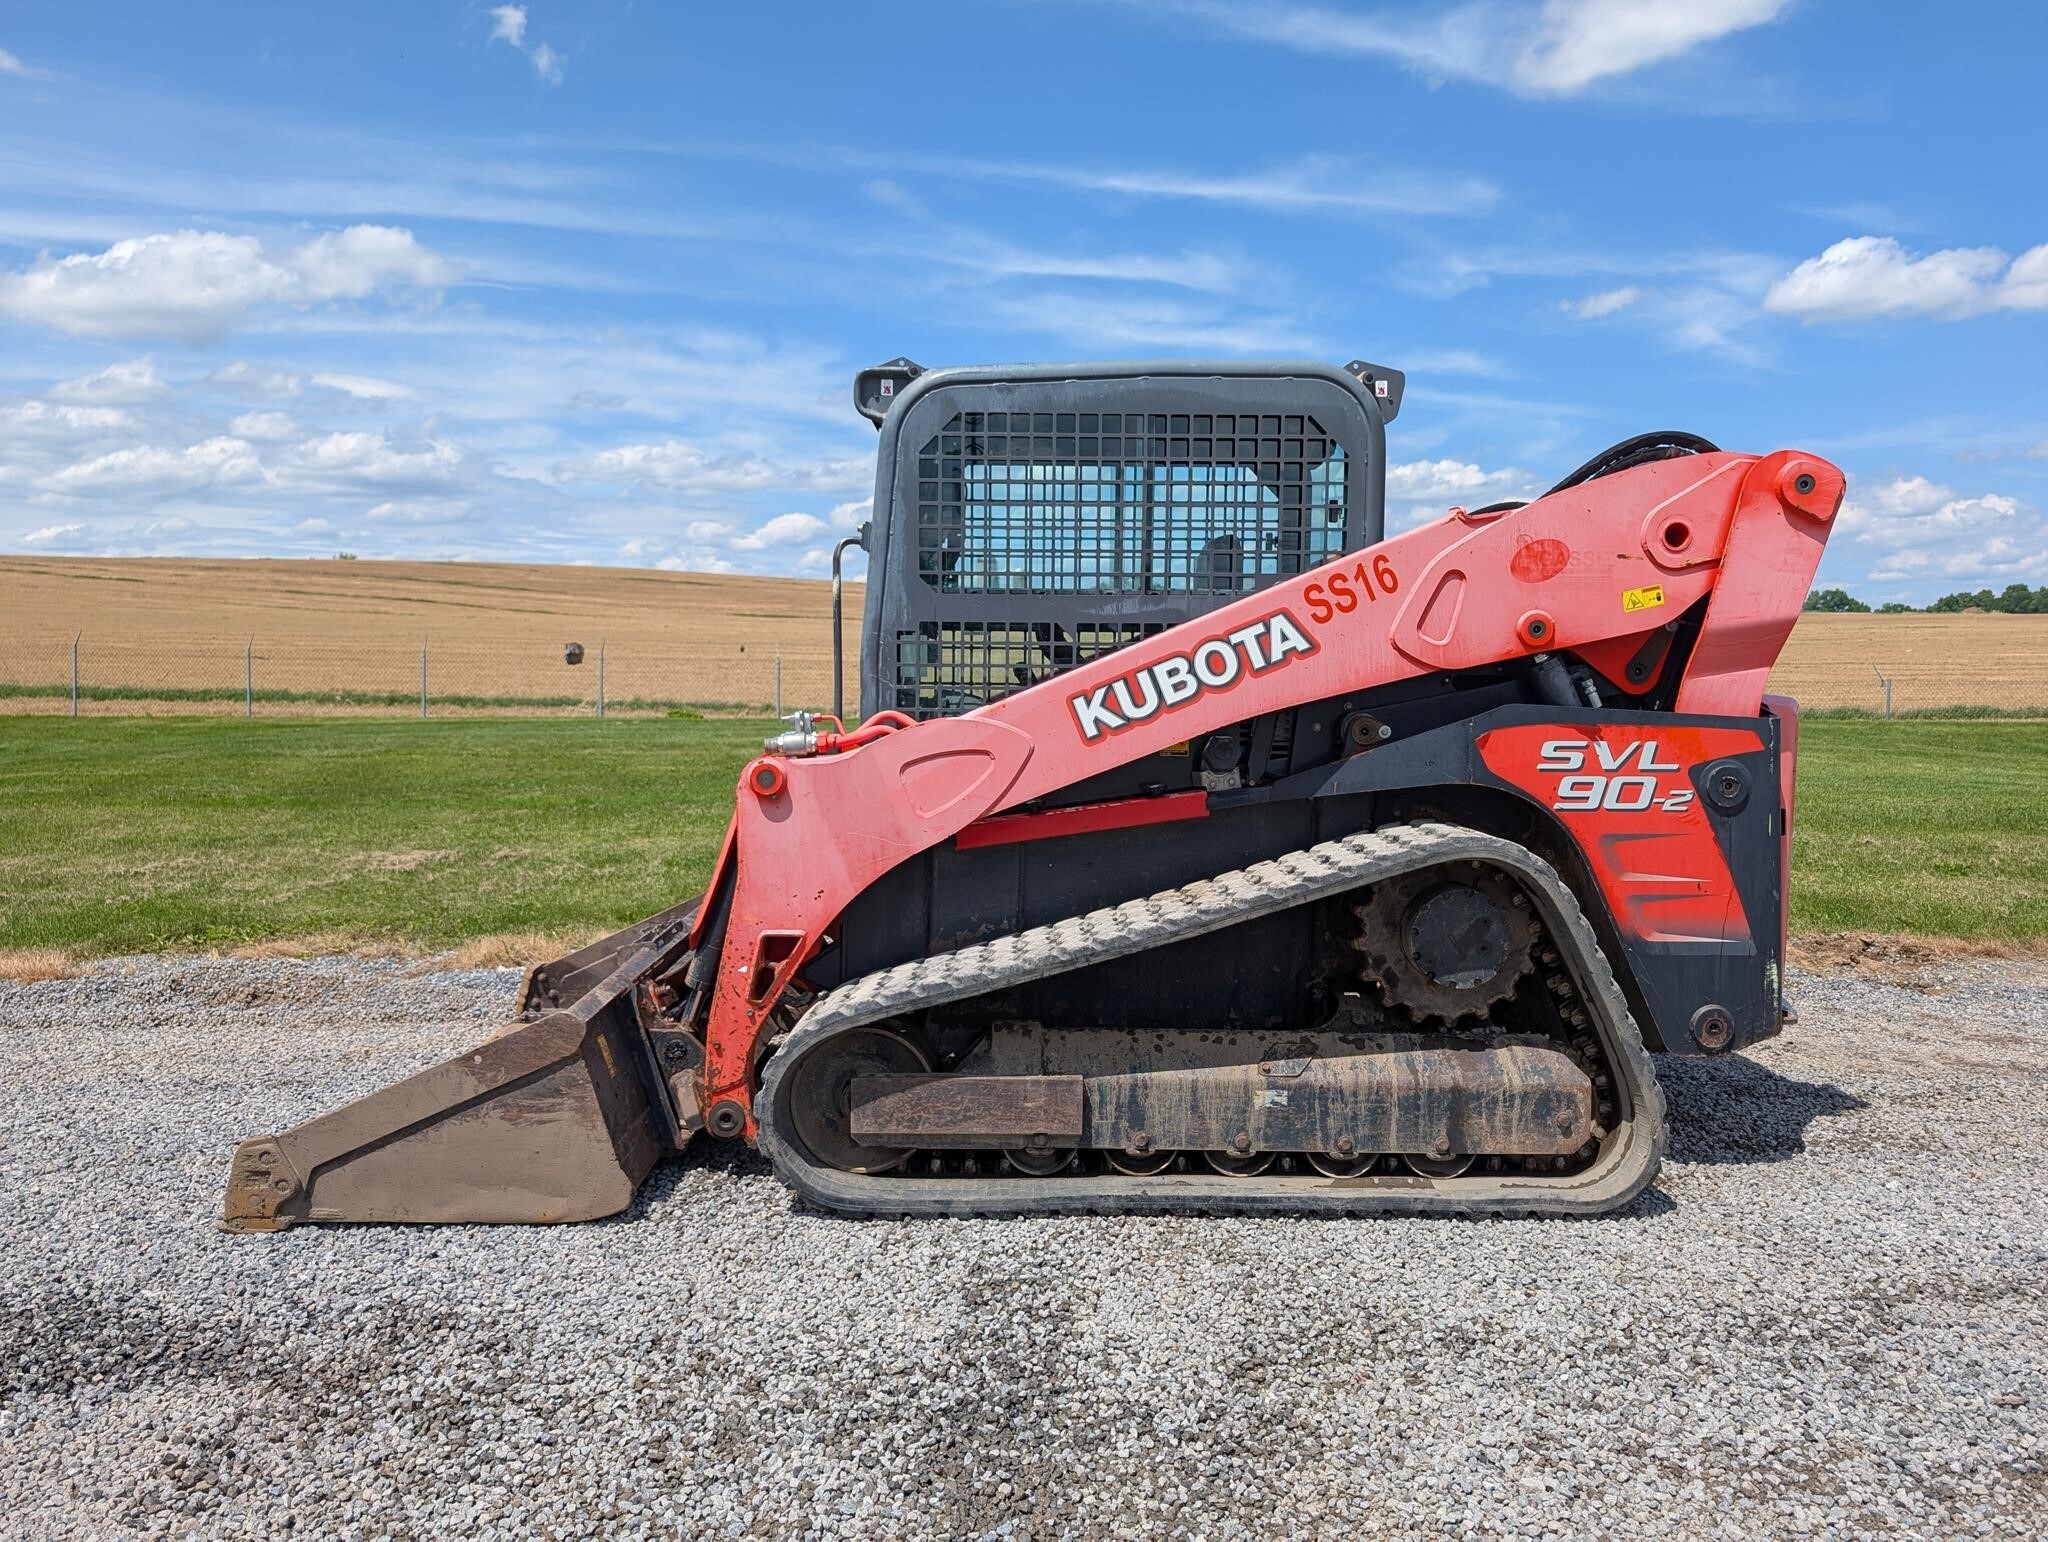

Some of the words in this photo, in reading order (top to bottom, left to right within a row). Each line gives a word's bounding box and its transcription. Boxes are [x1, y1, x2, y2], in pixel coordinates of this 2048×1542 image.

[1304, 554, 1399, 624] SS16
[1072, 613, 1312, 740] KUBOTA
[1536, 740, 1681, 771] SVL
[1553, 775, 1695, 812] 90-2
